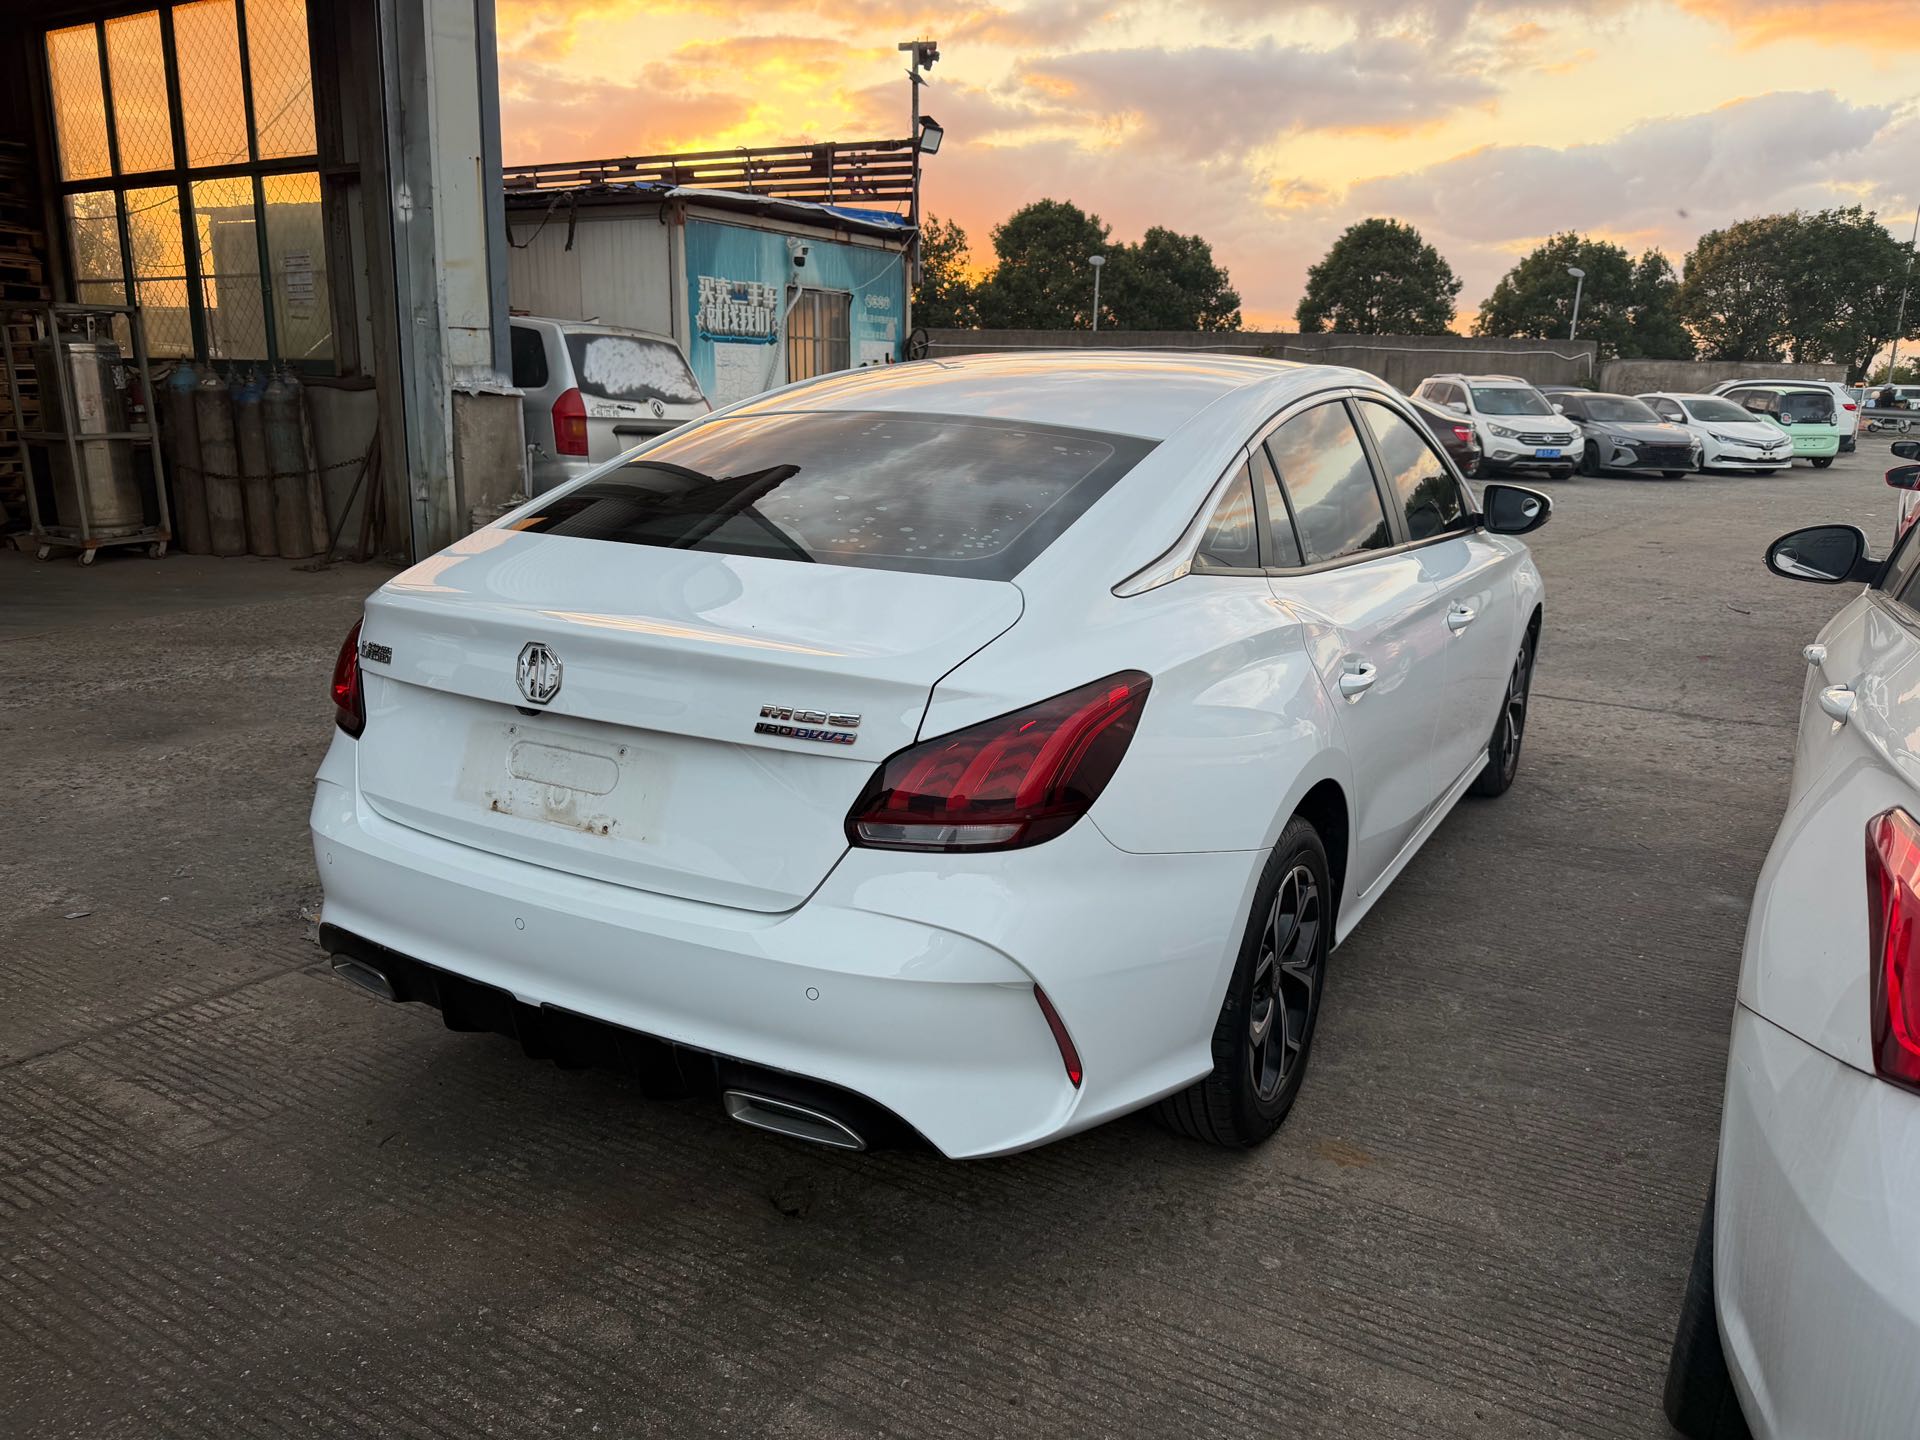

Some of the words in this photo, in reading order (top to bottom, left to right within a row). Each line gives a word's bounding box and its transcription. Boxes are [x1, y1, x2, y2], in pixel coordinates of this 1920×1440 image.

[698, 275, 778, 309] 买卖二手车
[706, 303, 771, 334] 就找我们
[517, 643, 562, 703] MG
[760, 704, 861, 728] MG5
